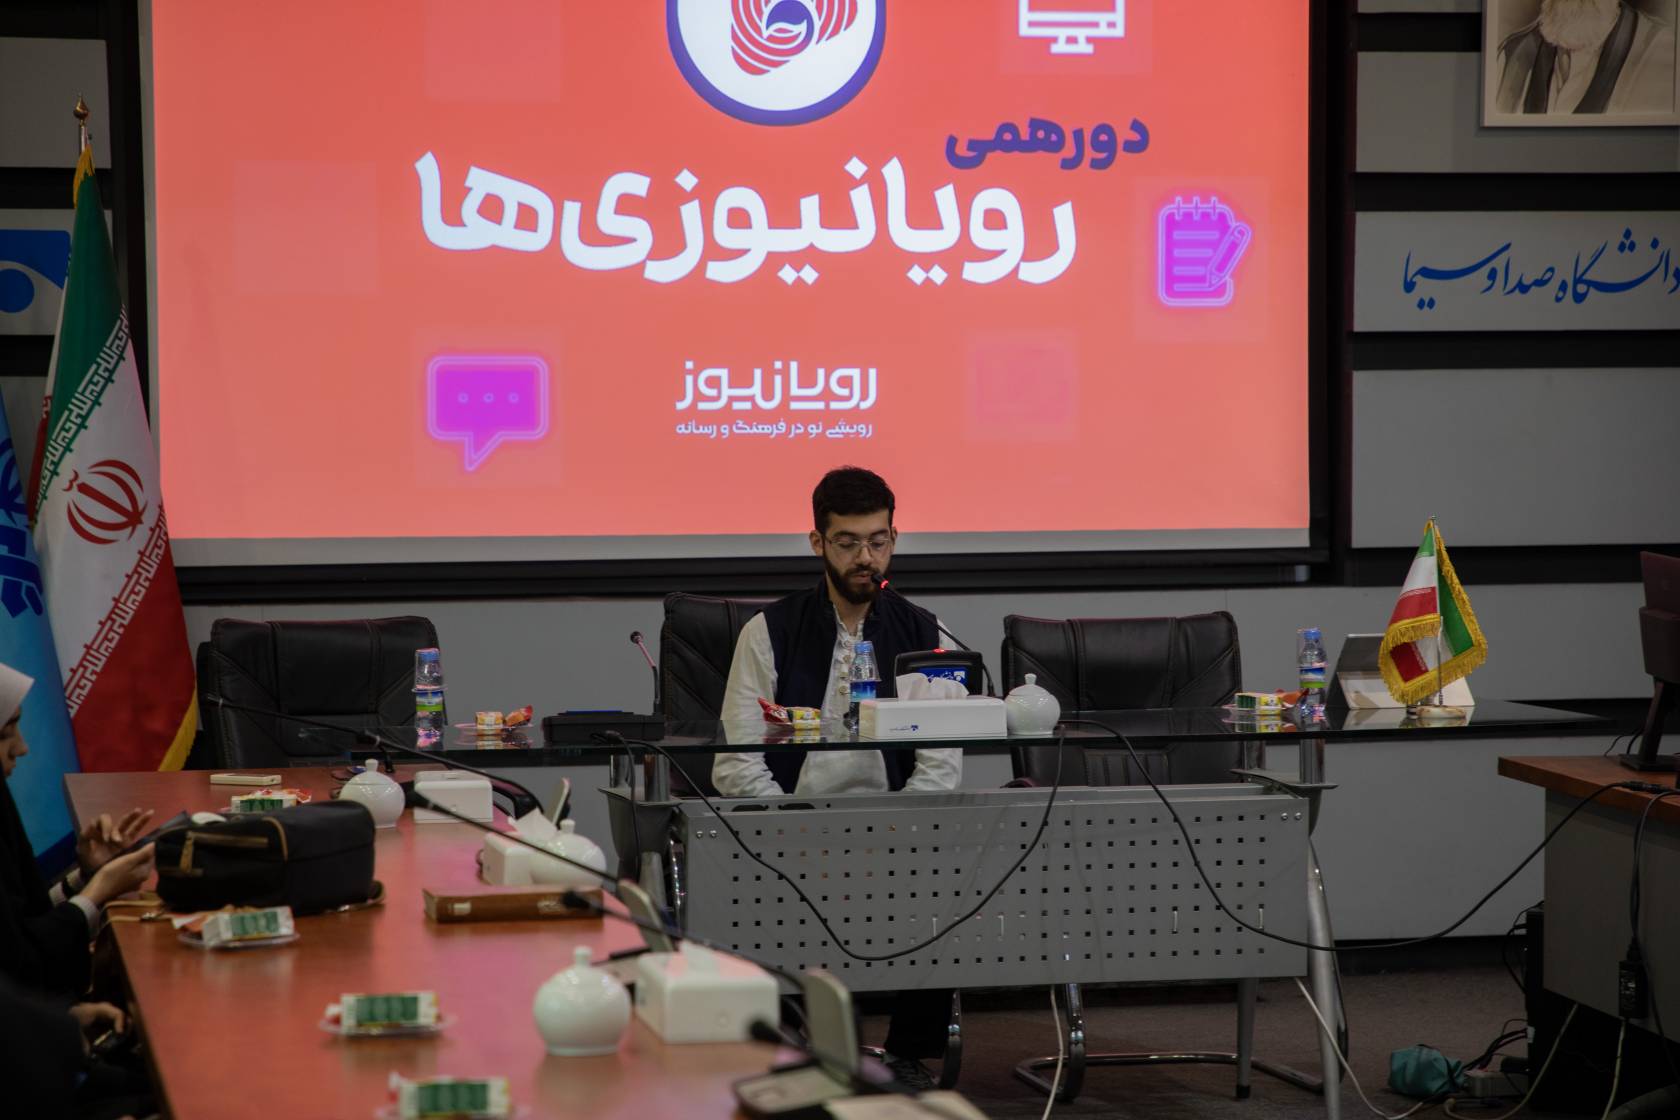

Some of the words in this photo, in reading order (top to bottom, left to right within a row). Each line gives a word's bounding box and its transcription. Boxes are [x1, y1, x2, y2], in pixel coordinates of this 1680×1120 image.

[945, 117, 1150, 171] دورهمی
[675, 419, 718, 439] رسانه
[719, 424, 730, 439] و
[732, 418, 787, 439] فرهنگ
[787, 422, 805, 439] در
[806, 421, 823, 439] نو
[825, 418, 873, 439] رویشی
